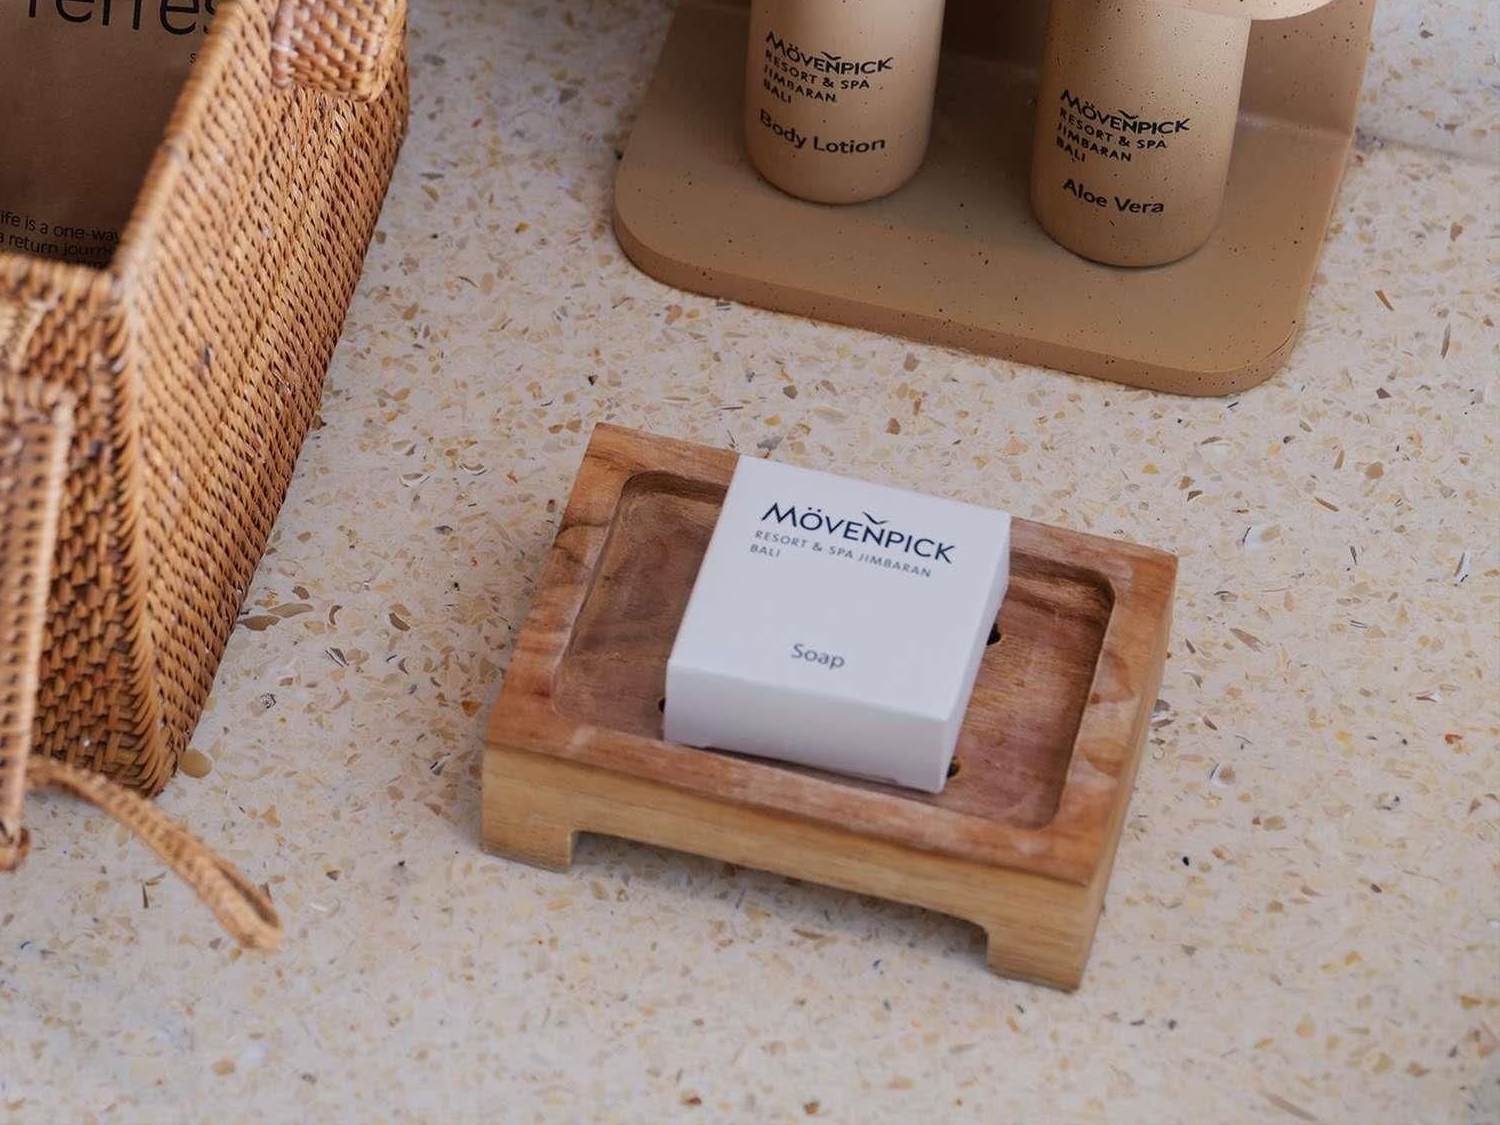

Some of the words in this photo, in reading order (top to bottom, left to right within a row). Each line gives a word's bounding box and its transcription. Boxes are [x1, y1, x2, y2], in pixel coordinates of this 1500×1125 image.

[765, 31, 894, 76] MÖVENPICK
[765, 49, 817, 84] RESORT
[822, 77, 834, 88] &
[840, 79, 869, 89] SPA
[763, 64, 836, 103] JIMBARAN
[763, 79, 791, 104] BALI
[760, 108, 807, 149] Body
[813, 135, 886, 154] Lotion
[1060, 89, 1190, 135] MÖVENPICK
[1060, 106, 1113, 142] RESORT
[1119, 136, 1130, 148] &
[1137, 139, 1168, 150] SPA
[1056, 137, 1086, 162] BALI
[1057, 122, 1132, 162] JIMBARAN
[1063, 178, 1108, 207] Aloe
[1114, 196, 1165, 214] Vera
[9, 233, 58, 254] return
[24, 214, 36, 231] is
[40, 222, 49, 235] a
[750, 544, 781, 558] BALI
[760, 502, 957, 565] MÖVENPICK
[755, 530, 807, 549] RESORT
[811, 540, 823, 553] &
[828, 545, 854, 559] SPA
[858, 553, 933, 578] JIMBARAN
[790, 642, 846, 671] Soap
